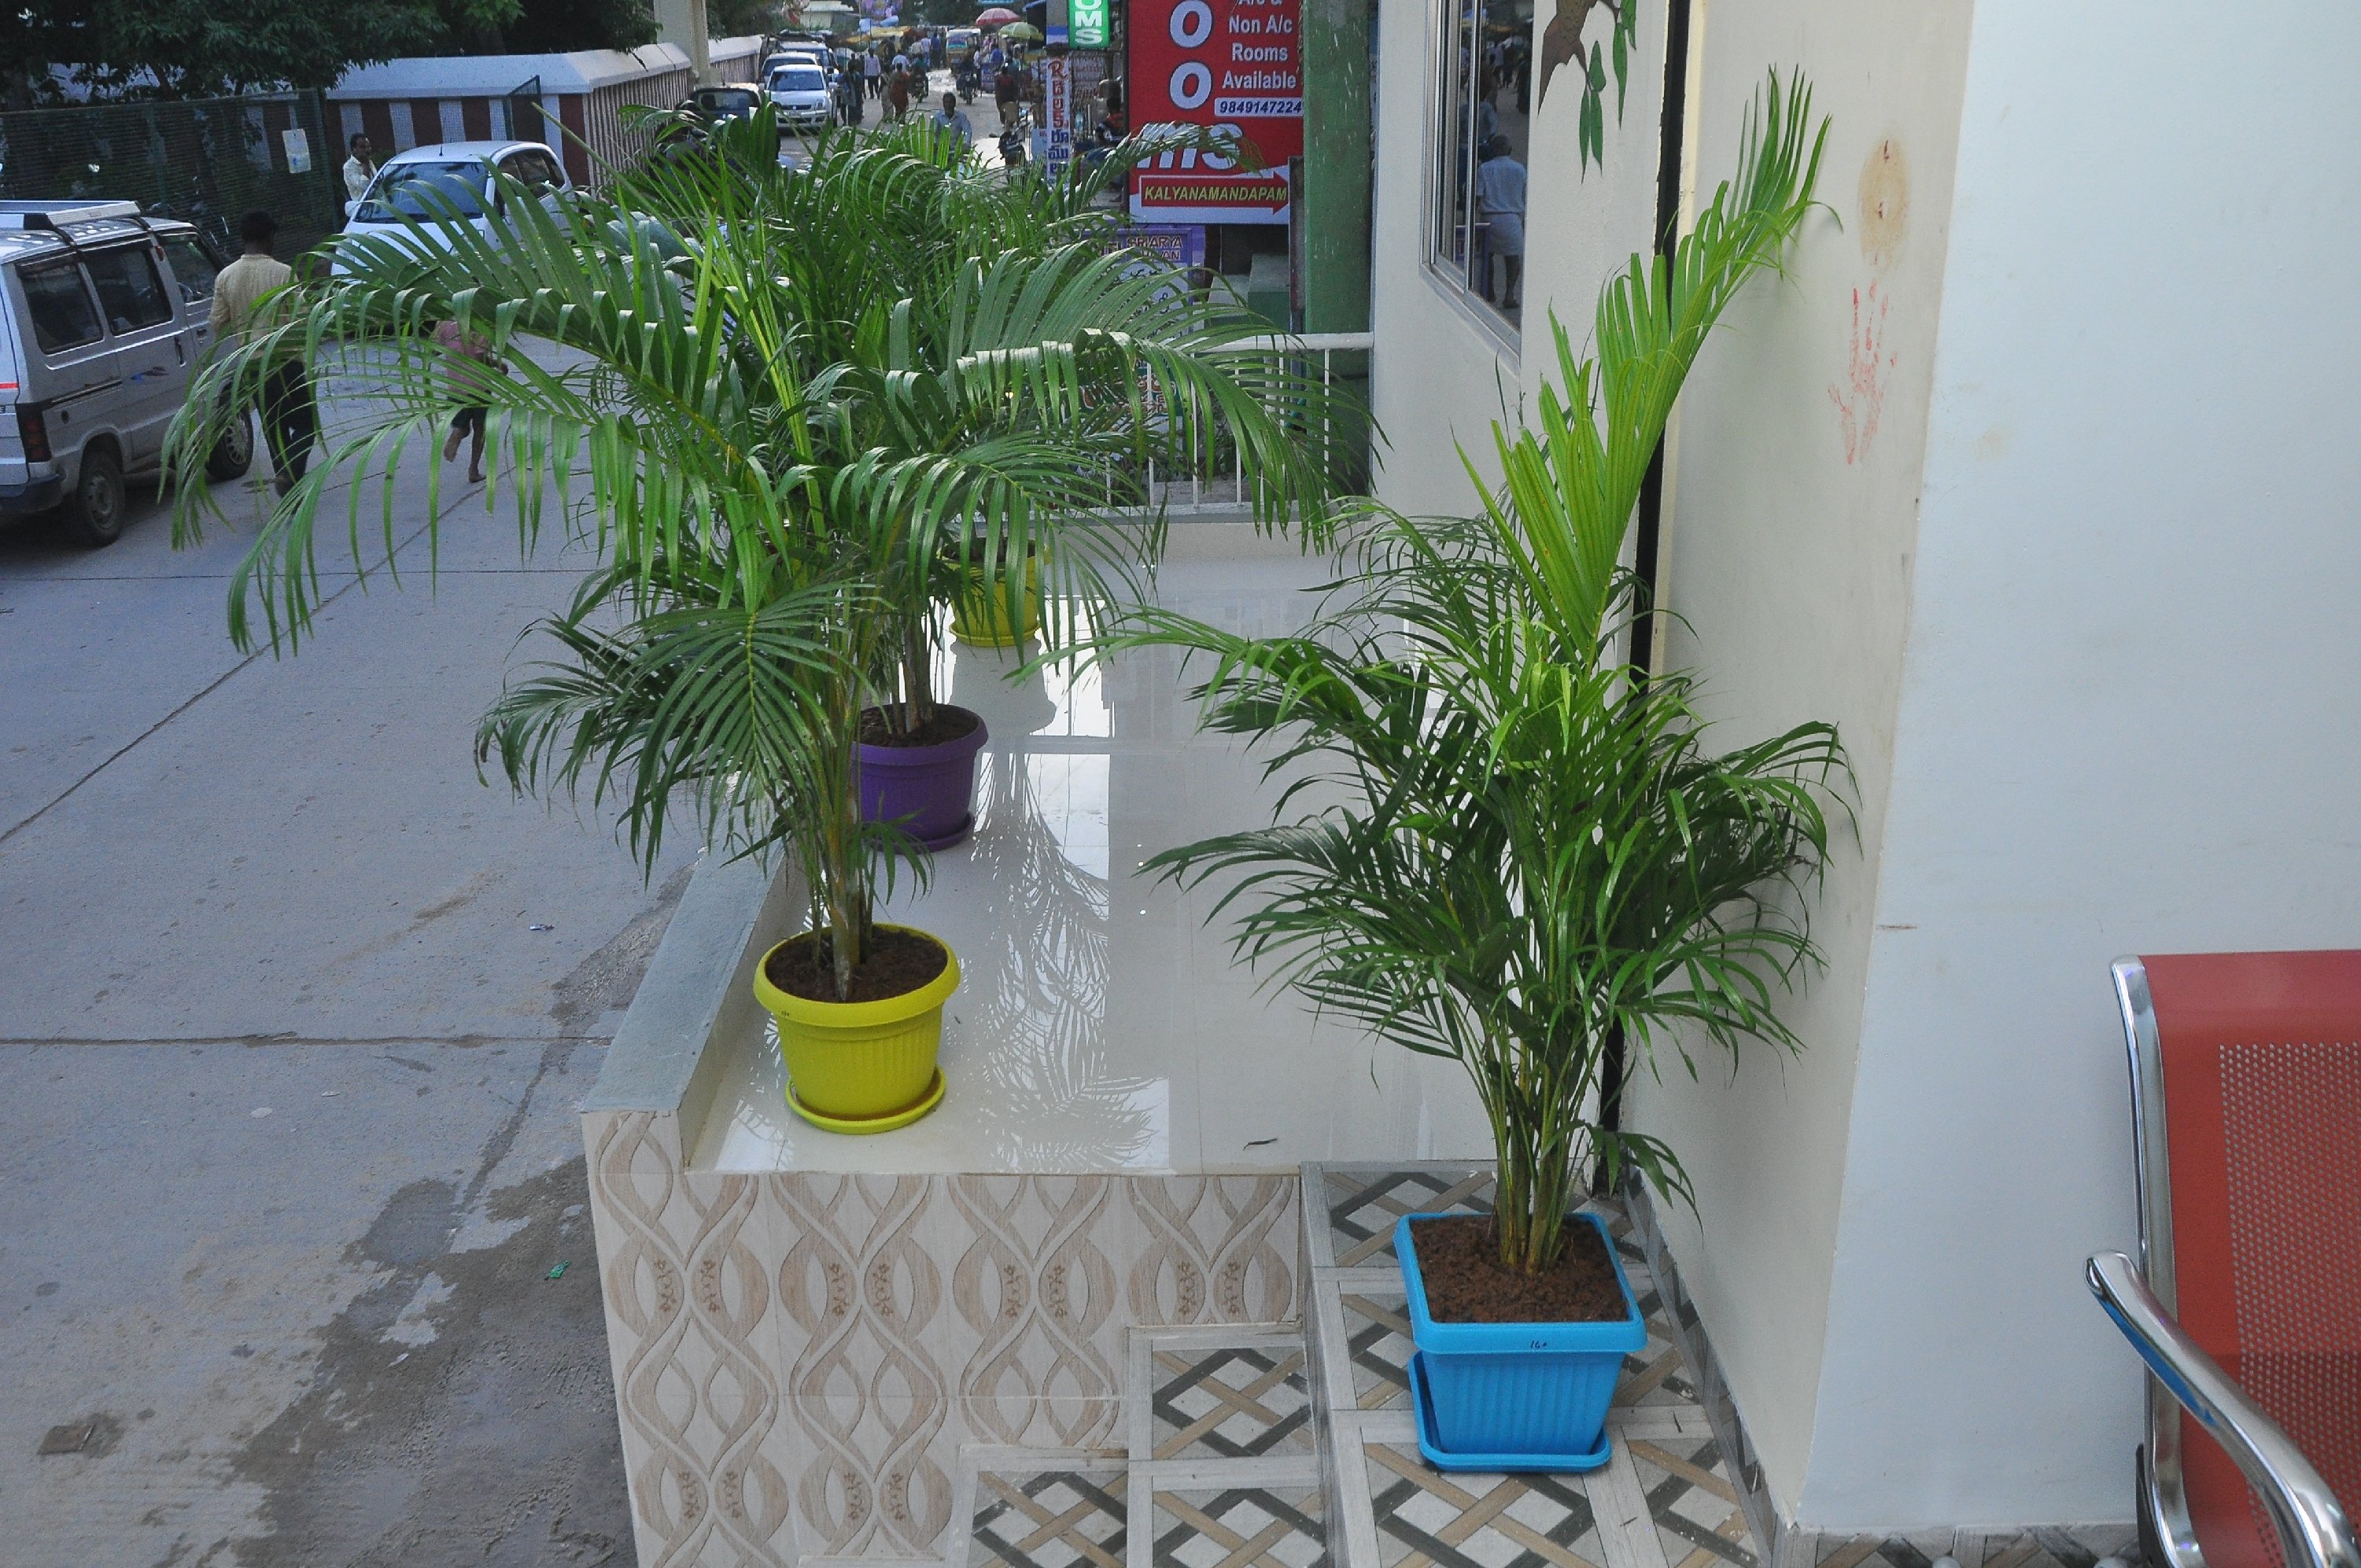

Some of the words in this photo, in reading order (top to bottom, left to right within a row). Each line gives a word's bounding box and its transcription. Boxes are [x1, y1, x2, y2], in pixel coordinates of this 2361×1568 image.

[1229, 15, 1260, 33] Non
[1265, 14, 1293, 33] A/c
[1231, 42, 1289, 61] Rooms
[1222, 70, 1297, 89] Available
[1219, 101, 1302, 113] 9849147224
[1145, 186, 1287, 201] KALYANAMANDAPAM
